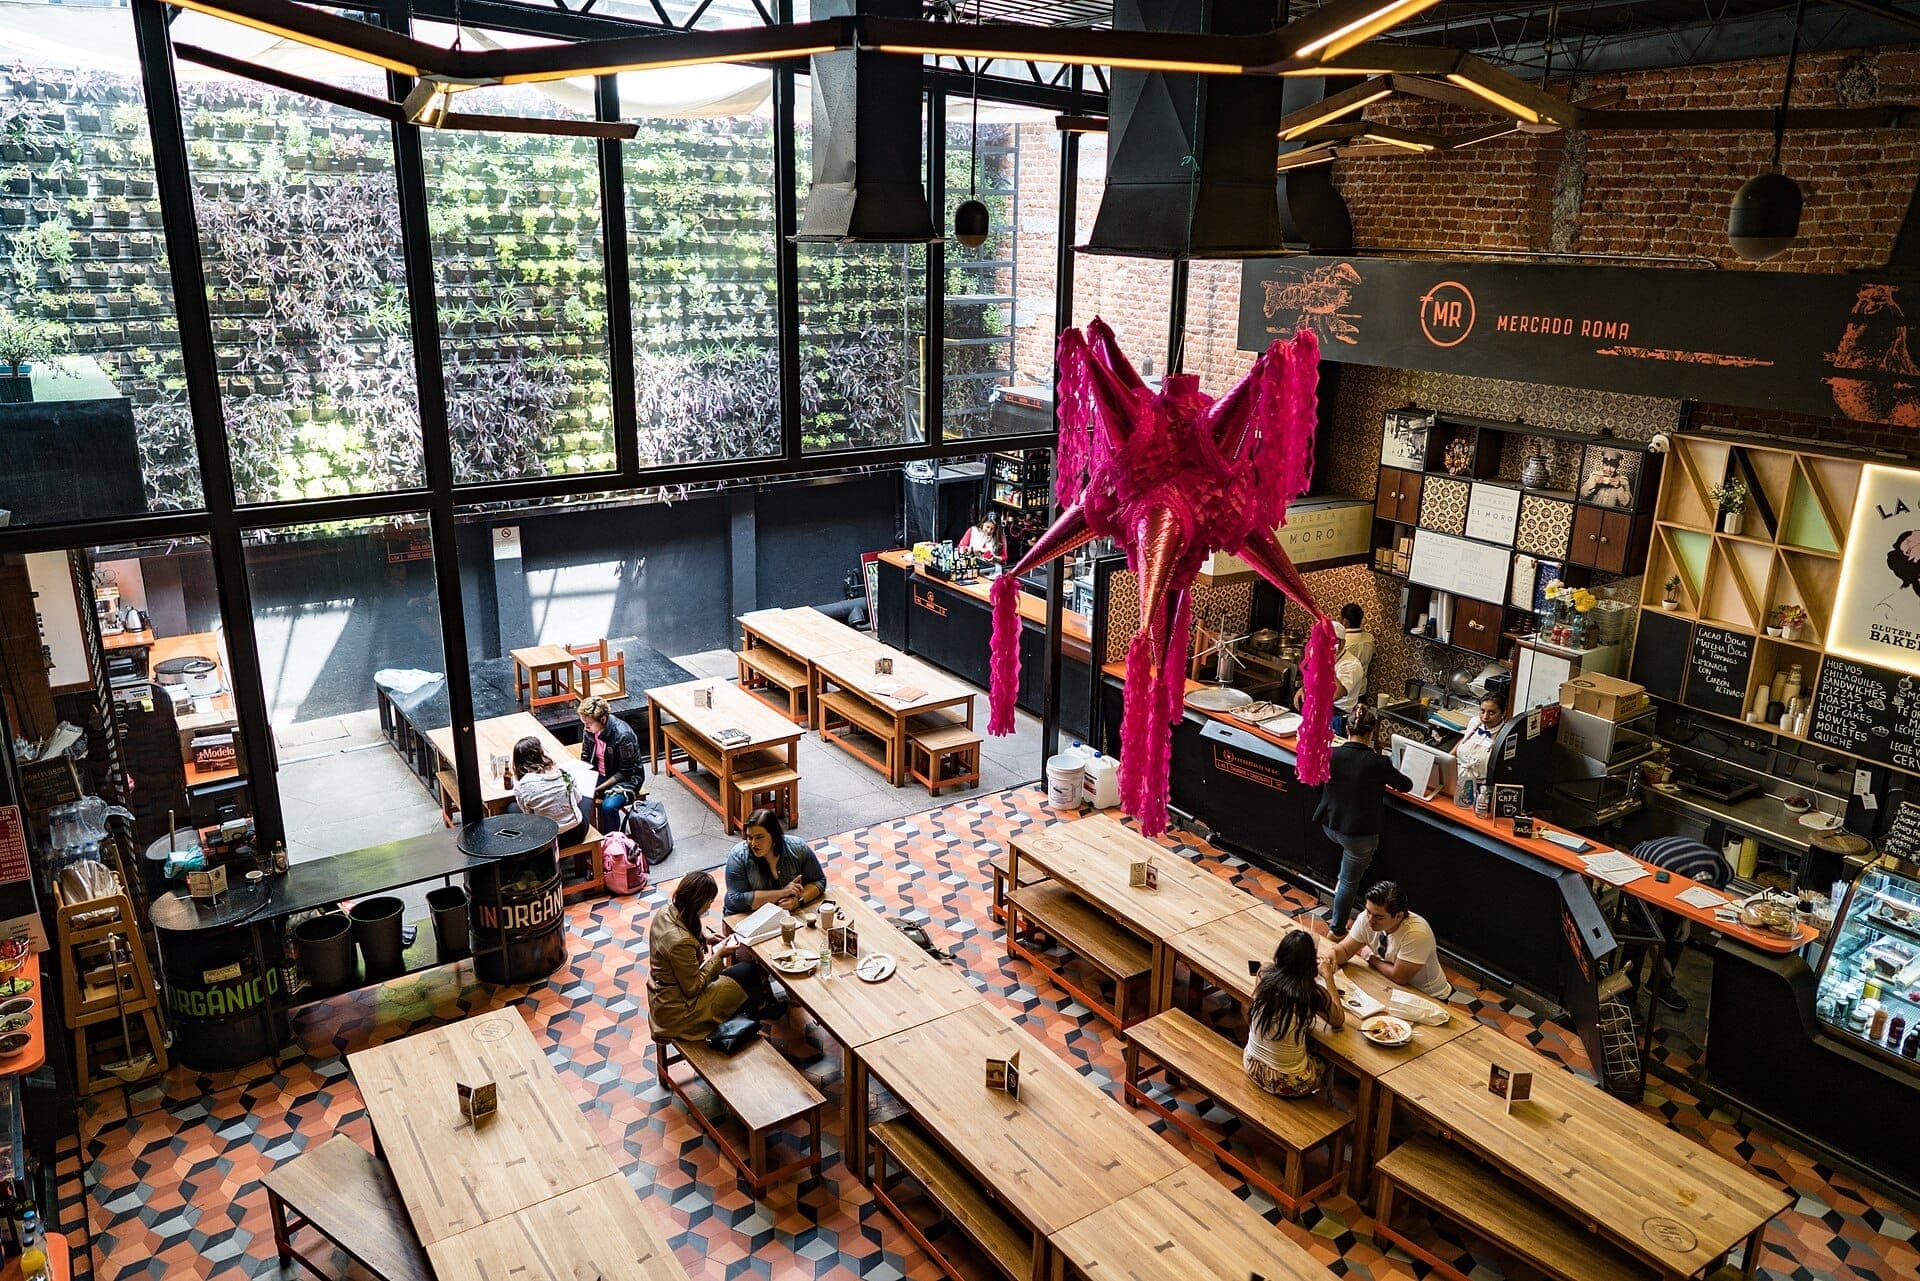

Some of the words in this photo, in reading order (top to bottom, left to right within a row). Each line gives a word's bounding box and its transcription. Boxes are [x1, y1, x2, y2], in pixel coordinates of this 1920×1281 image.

[1432, 301, 1462, 328] MR
[1496, 315, 1573, 336] MERCADO
[1581, 319, 1630, 340] ROMA
[1485, 511, 1513, 523] MORO
[1876, 498, 1911, 520] LA
[1289, 528, 1335, 545] MORO
[1871, 623, 1912, 638] GLUTEN
[1826, 660, 1863, 675] HUEVOS
[1822, 676, 1887, 700] SANDWICHES
[1823, 668, 1884, 690] CHILAQUILES
[132, 691, 147, 699] VISA
[1819, 692, 1864, 712] TOASTS
[1822, 684, 1862, 702] PIZZAS
[1817, 711, 1857, 730] BOWLS
[1819, 702, 1840, 715] HOT
[1841, 709, 1873, 724] CAKES
[1814, 731, 1853, 749] QUICHE
[1815, 721, 1868, 742] MOLLETES
[202, 746, 236, 760] Modelo
[1890, 740, 1913, 755] LECHE
